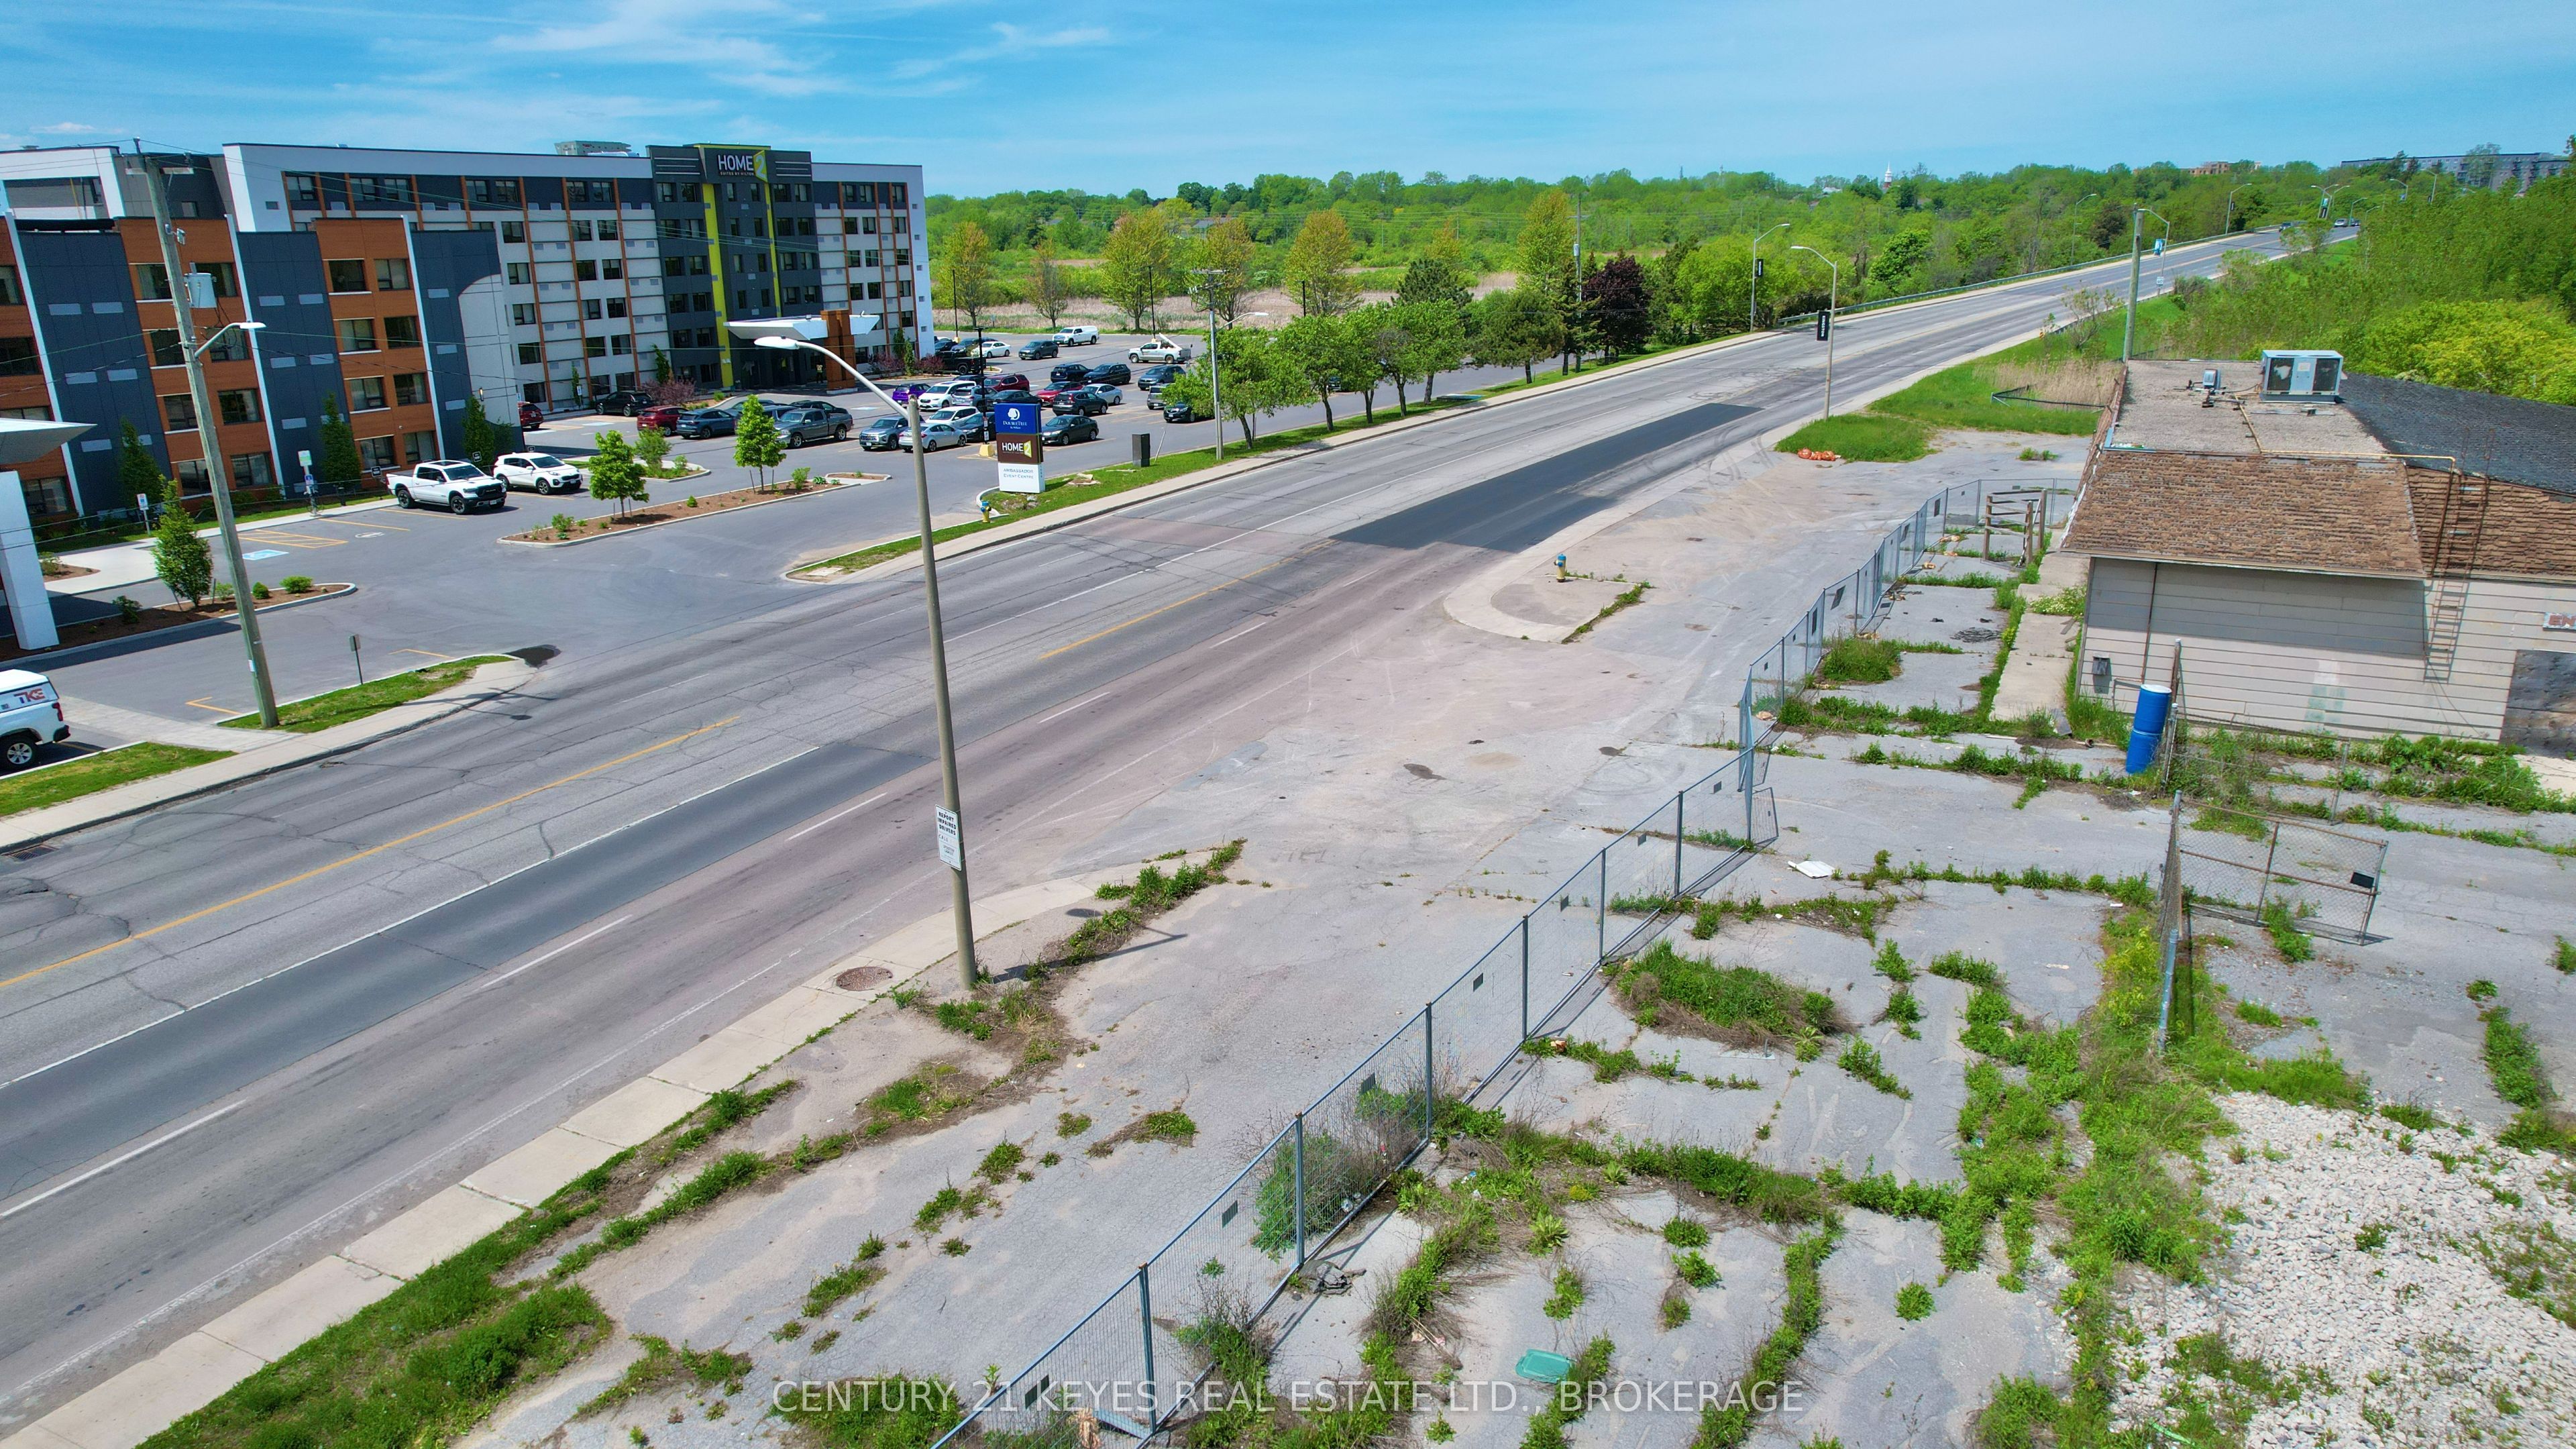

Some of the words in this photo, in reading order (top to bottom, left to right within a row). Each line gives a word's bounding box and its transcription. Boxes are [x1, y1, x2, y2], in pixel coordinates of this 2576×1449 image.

[13, 688, 46, 704] TKE
[938, 812, 954, 822] REPORT
[937, 818, 957, 830] IMPAIRED
[939, 824, 956, 836] DRIVERS
[938, 834, 948, 843] CALL
